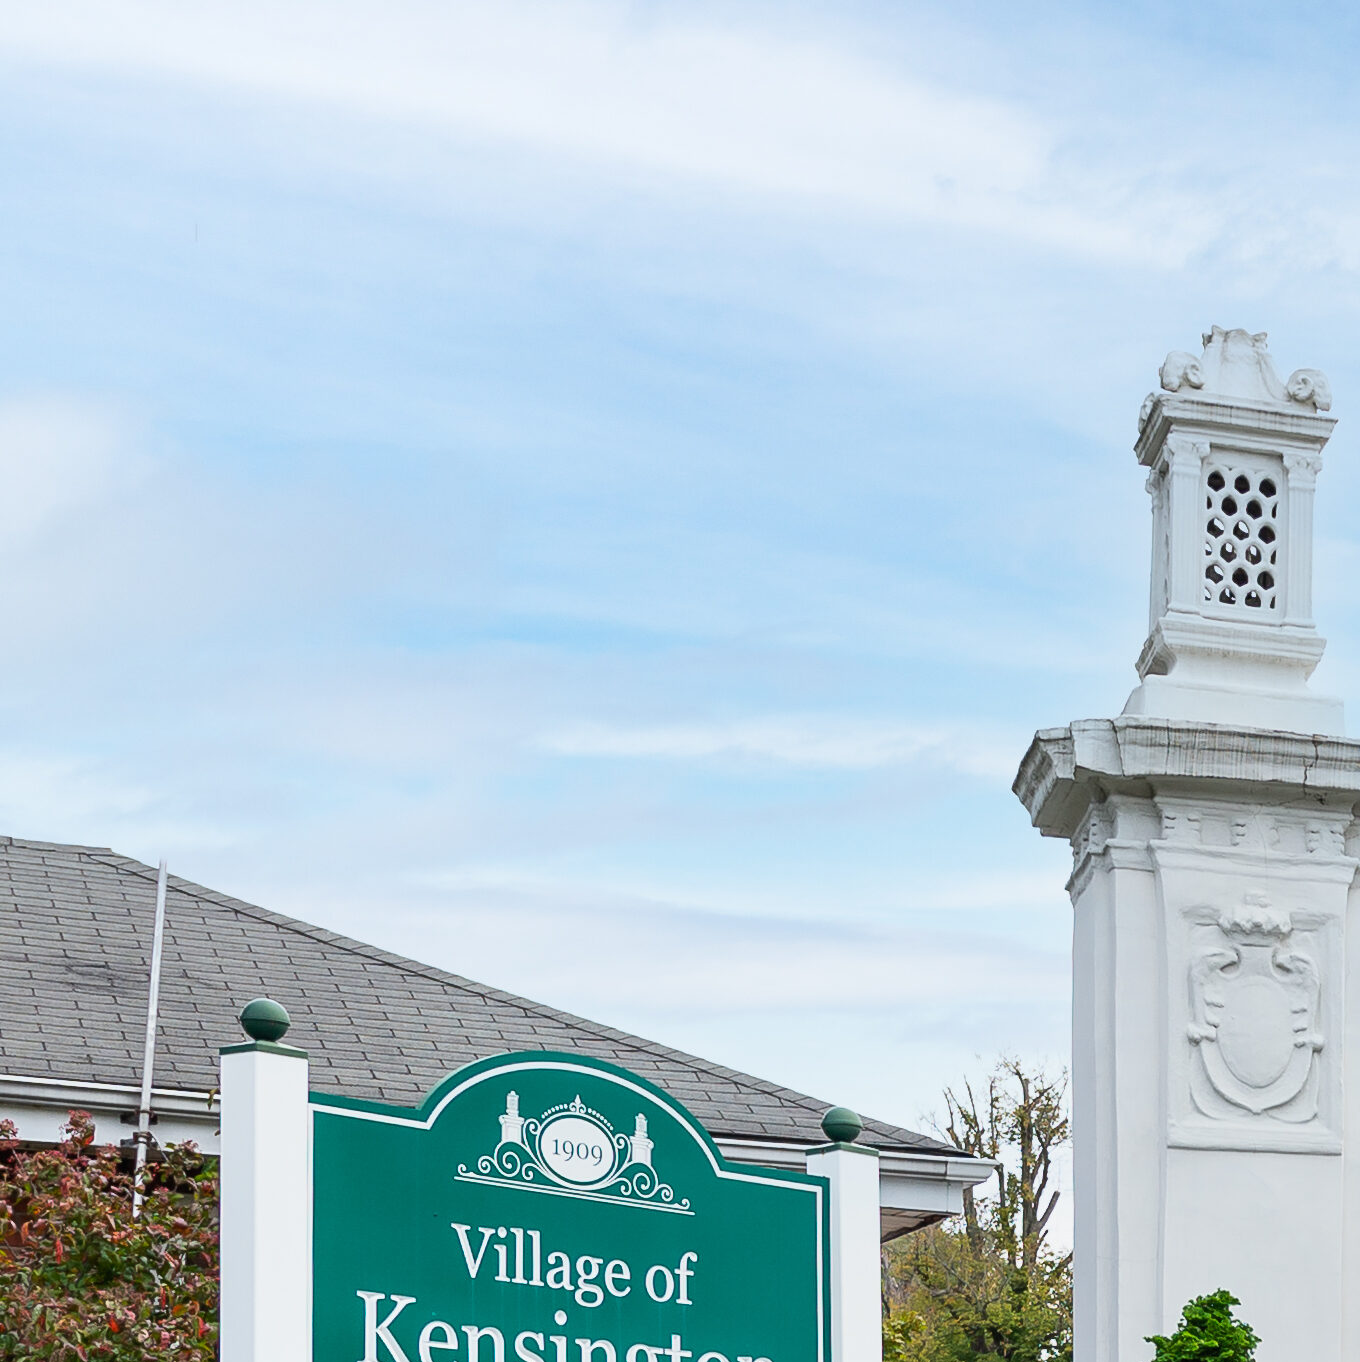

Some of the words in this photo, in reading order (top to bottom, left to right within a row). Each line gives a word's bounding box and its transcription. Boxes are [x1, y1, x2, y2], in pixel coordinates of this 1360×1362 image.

[552, 1138, 603, 1166] 1909
[450, 1222, 631, 1308] Village
[645, 1251, 698, 1305] of
